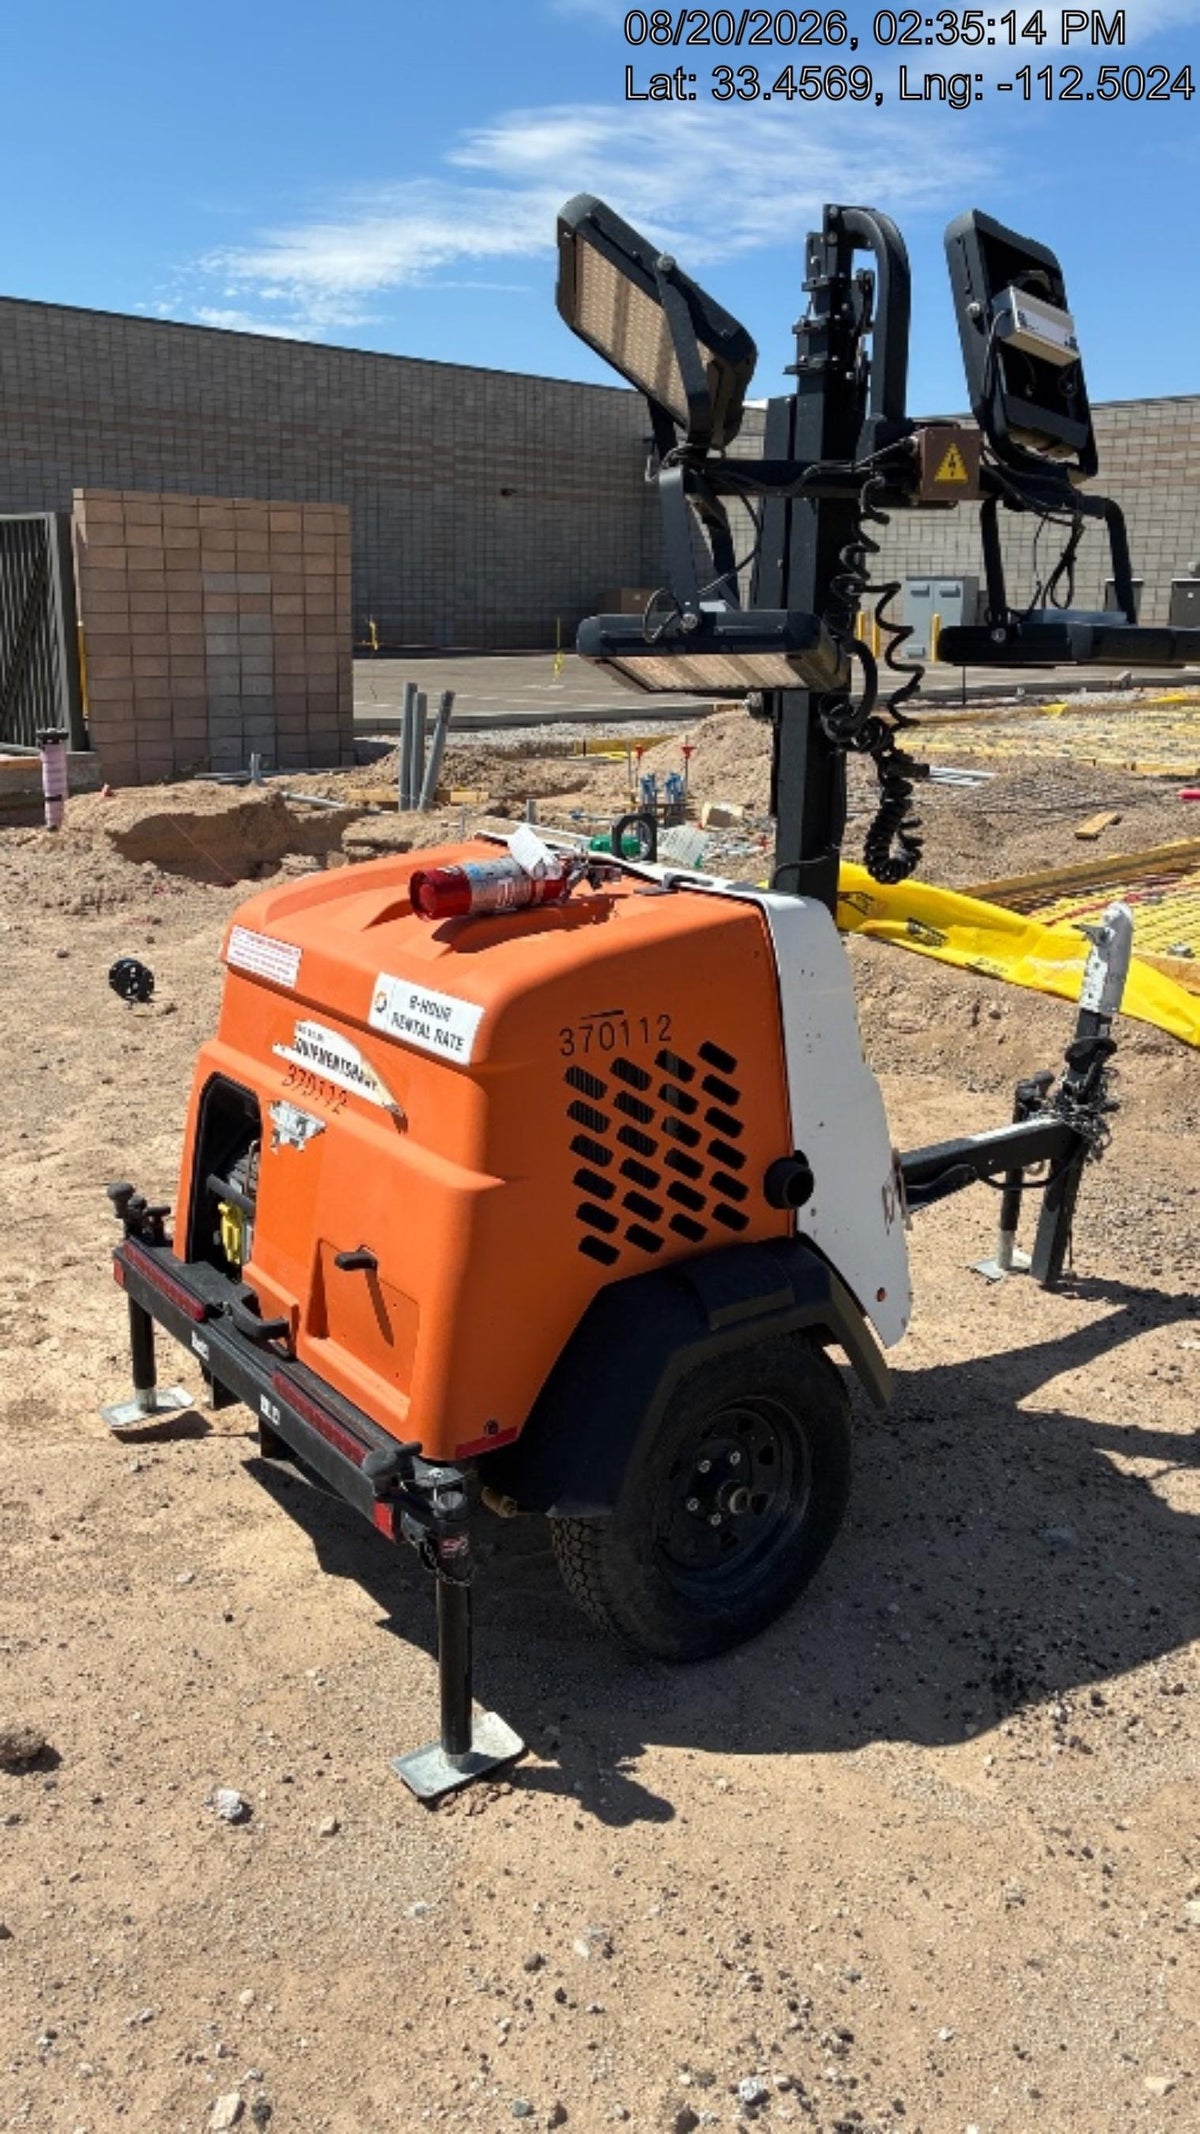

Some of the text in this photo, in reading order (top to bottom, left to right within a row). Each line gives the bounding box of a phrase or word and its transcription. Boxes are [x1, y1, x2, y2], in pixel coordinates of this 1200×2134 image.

[391, 1011, 465, 1052] RENTAL RATE
[559, 1013, 672, 1056] 370112
